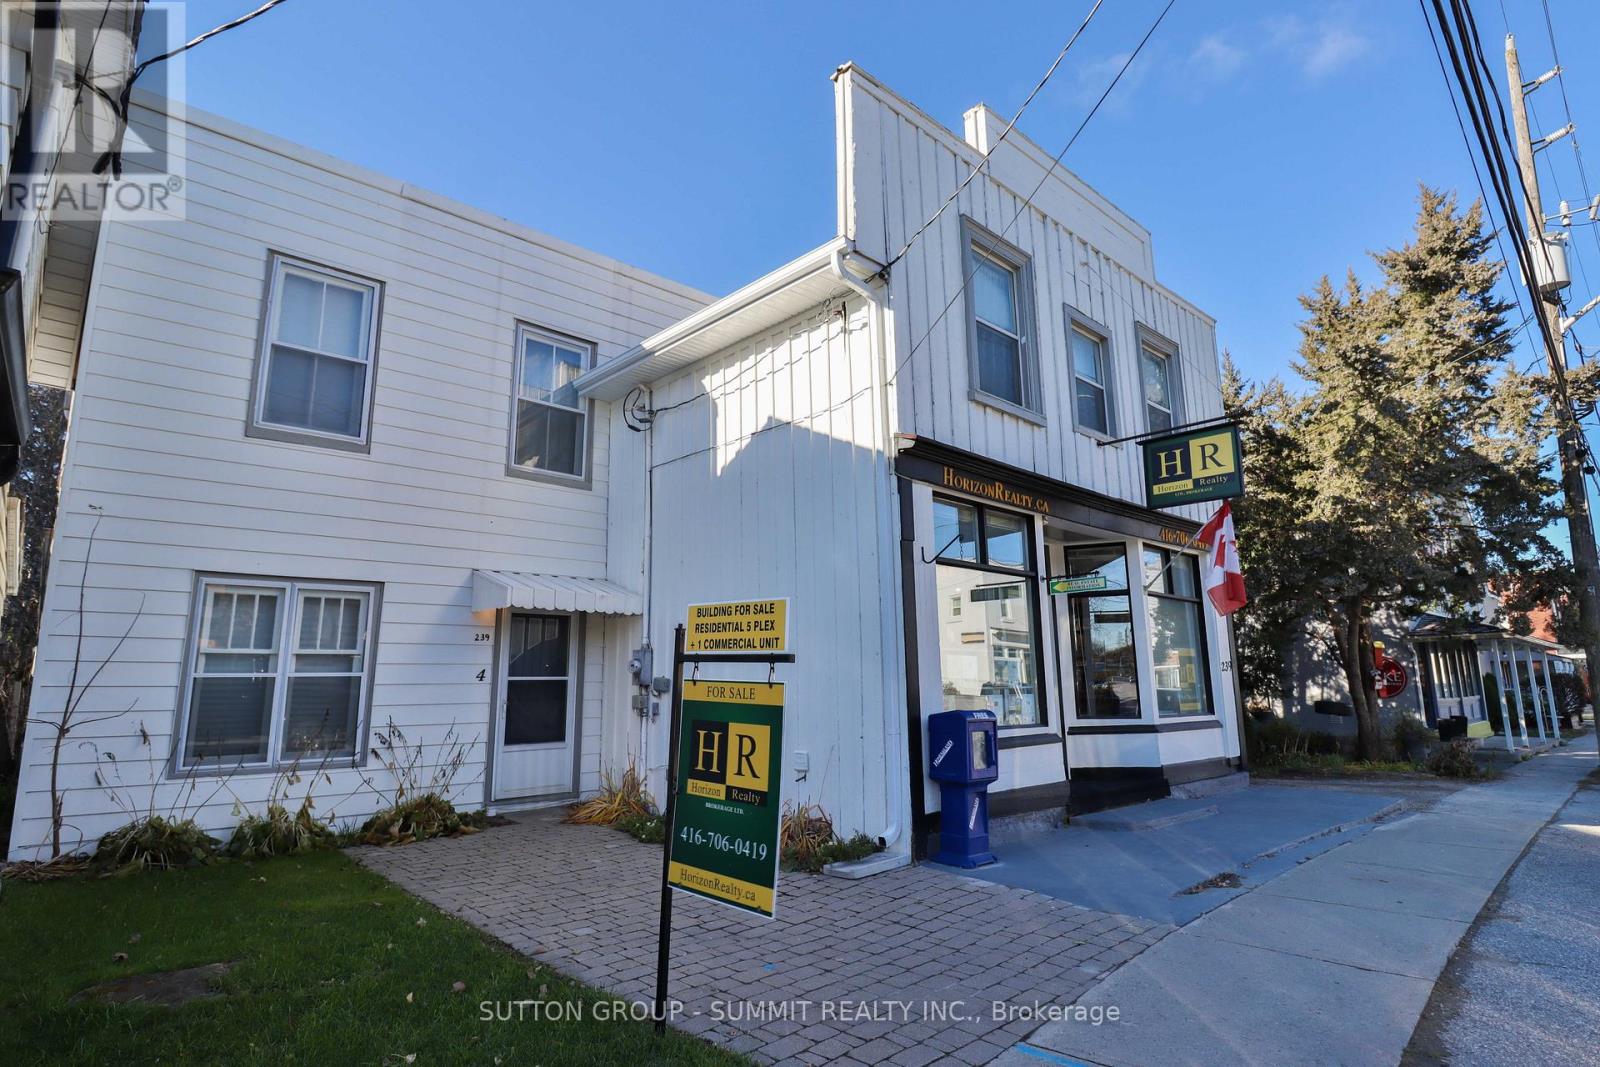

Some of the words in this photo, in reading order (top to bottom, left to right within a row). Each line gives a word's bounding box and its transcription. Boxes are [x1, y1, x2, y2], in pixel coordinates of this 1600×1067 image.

[1157, 482, 1188, 493] Horizon
[1199, 475, 1229, 486] Realty
[696, 605, 733, 618] BUILDING
[734, 604, 751, 616] FOR
[753, 603, 775, 615] SALE
[695, 621, 745, 634] RESIDENTIAL
[746, 621, 752, 632] 5
[754, 620, 776, 632] PLEX
[474, 633, 490, 641] 239
[703, 638, 758, 650] COMMERCIAL
[759, 637, 780, 649] UNIT
[475, 668, 486, 682] 4
[706, 685, 726, 698] FOR
[728, 687, 756, 700] SALE
[691, 781, 721, 797] Horizon
[731, 788, 761, 806] Realty
[680, 825, 768, 861] 416-706-0419
[680, 868, 756, 901] HorizonRealty.ca
